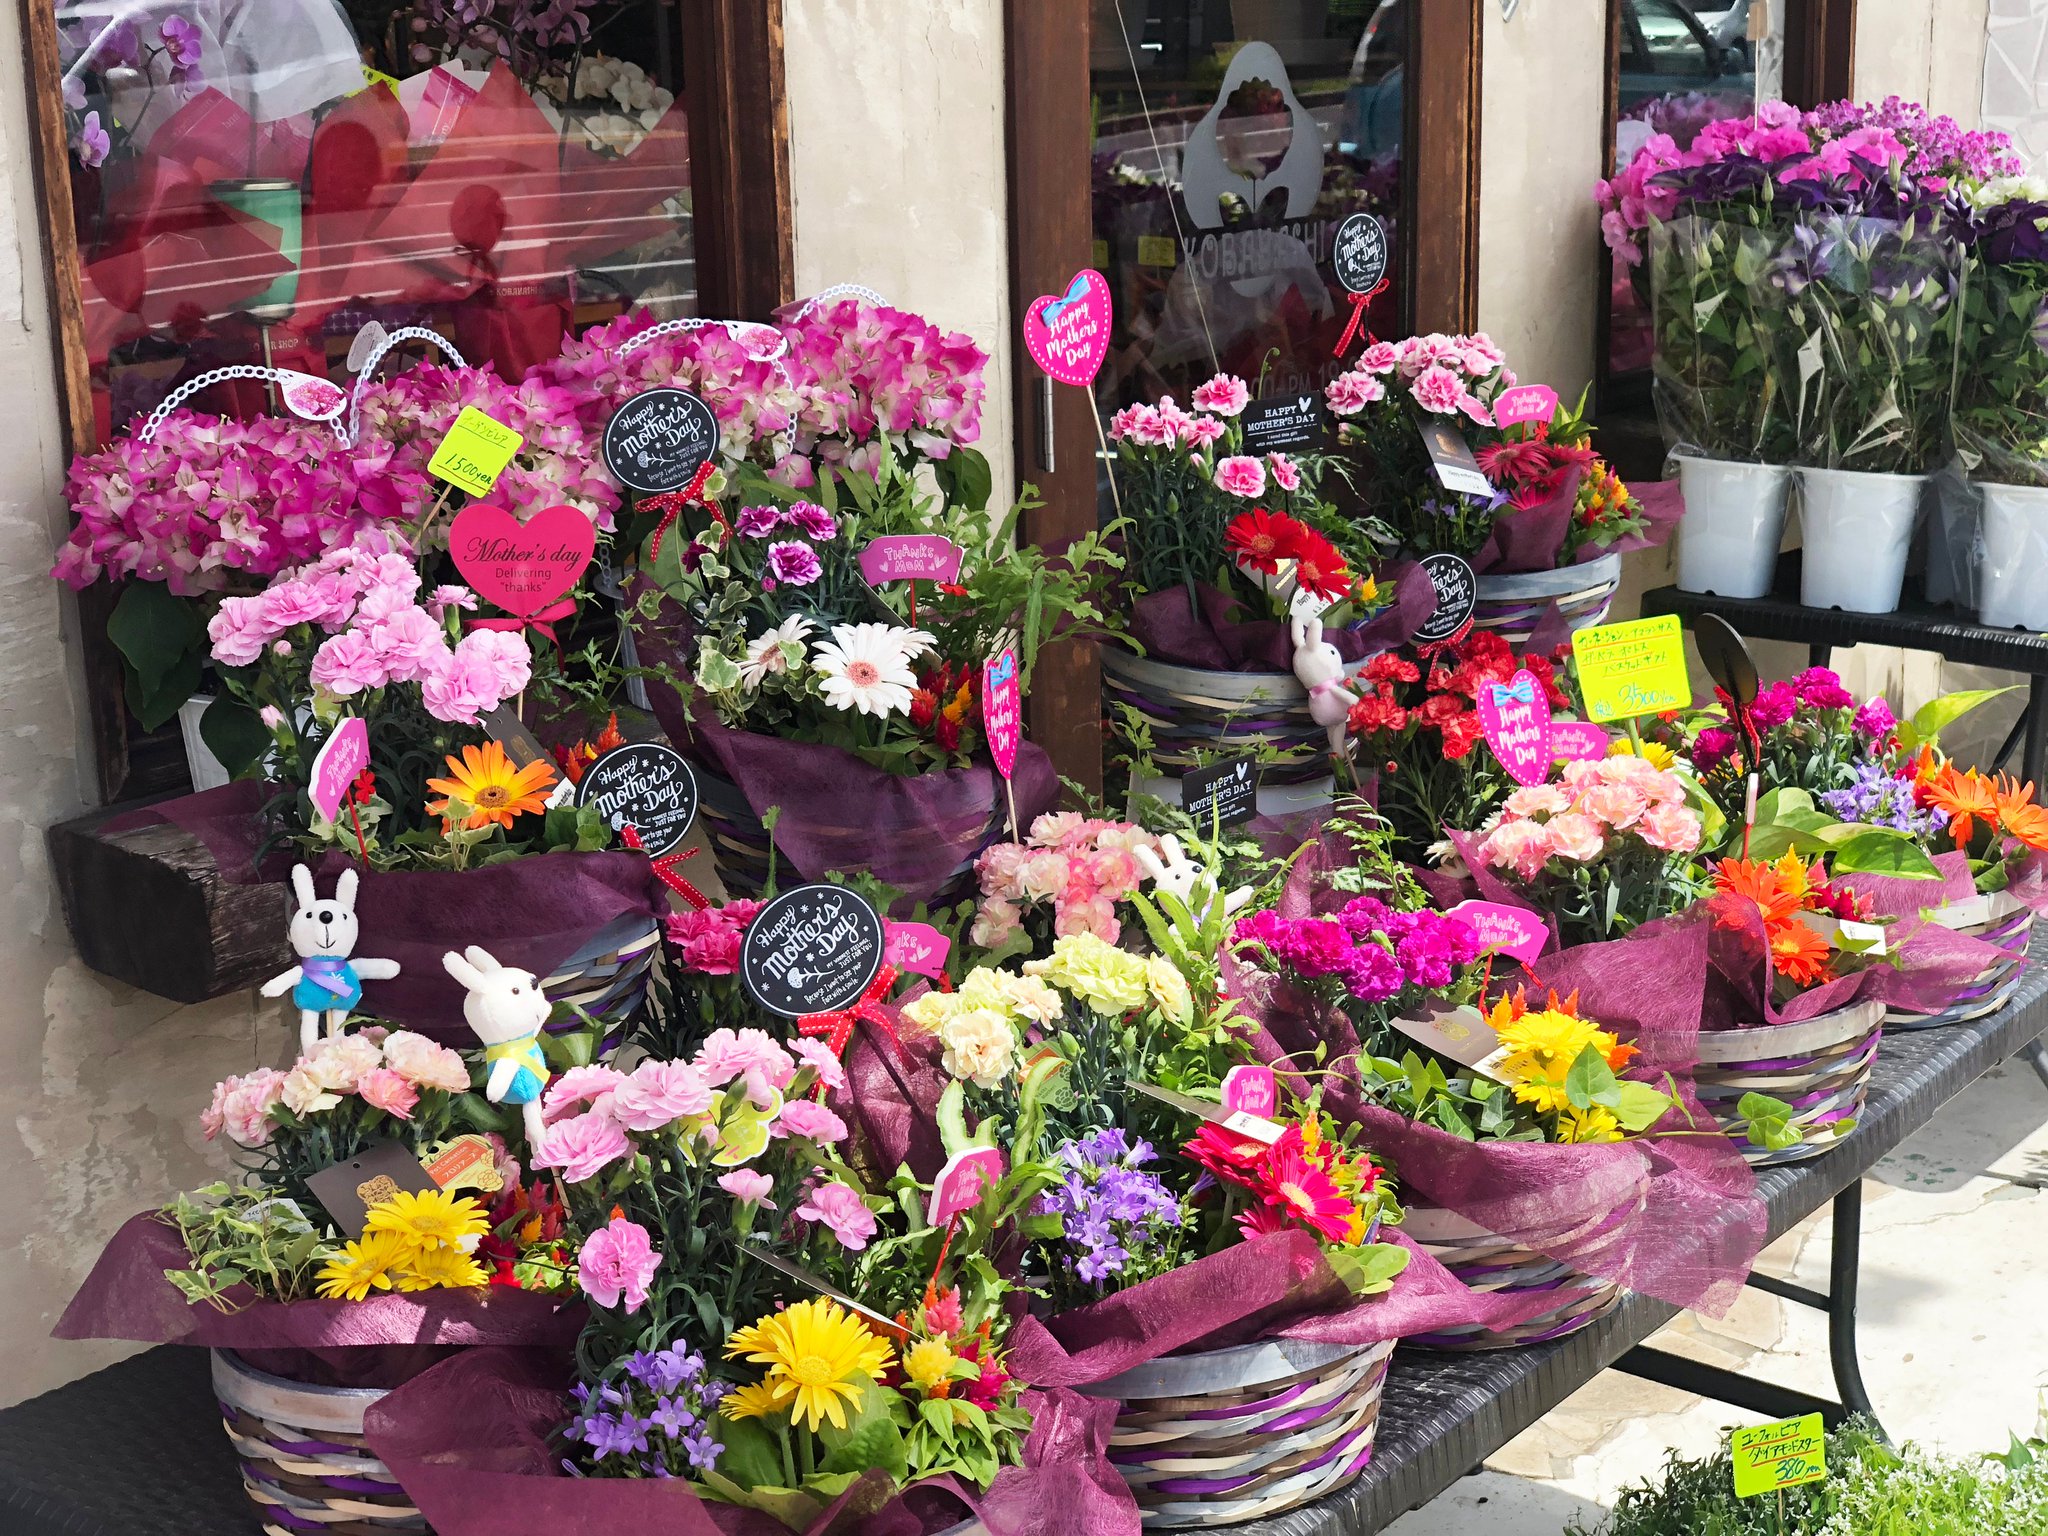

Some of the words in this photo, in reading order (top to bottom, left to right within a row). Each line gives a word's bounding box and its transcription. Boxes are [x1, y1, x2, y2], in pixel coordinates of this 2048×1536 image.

[1362, 242, 1381, 261] Day
[1050, 302, 1089, 338] Happy
[1066, 342, 1091, 367] Day
[618, 401, 654, 431] Happy
[1248, 416, 1294, 432] MOTHER'S
[1296, 414, 1316, 424] DAY
[1265, 405, 1297, 418] HAPPY
[619, 401, 692, 458] Mother's
[665, 418, 701, 447] Day
[464, 537, 546, 562] Mother's
[550, 544, 583, 572] day
[884, 543, 934, 560] THANKS
[496, 567, 552, 580] Delivering
[1440, 580, 1468, 602] Day
[1498, 704, 1532, 728] Happy
[1515, 746, 1536, 766] Day
[598, 754, 638, 785] Happy
[593, 760, 676, 818] Mother's
[1205, 774, 1235, 793] HAPPY
[1233, 780, 1252, 794] DAY
[643, 781, 683, 812] Day
[756, 904, 794, 948] Happy
[816, 912, 858, 956] Day
[1473, 912, 1521, 933] THANKS
[762, 895, 842, 980] Mother's
[838, 956, 852, 968] JUST
[852, 949, 863, 960] FOR
[861, 942, 872, 952] YOU
